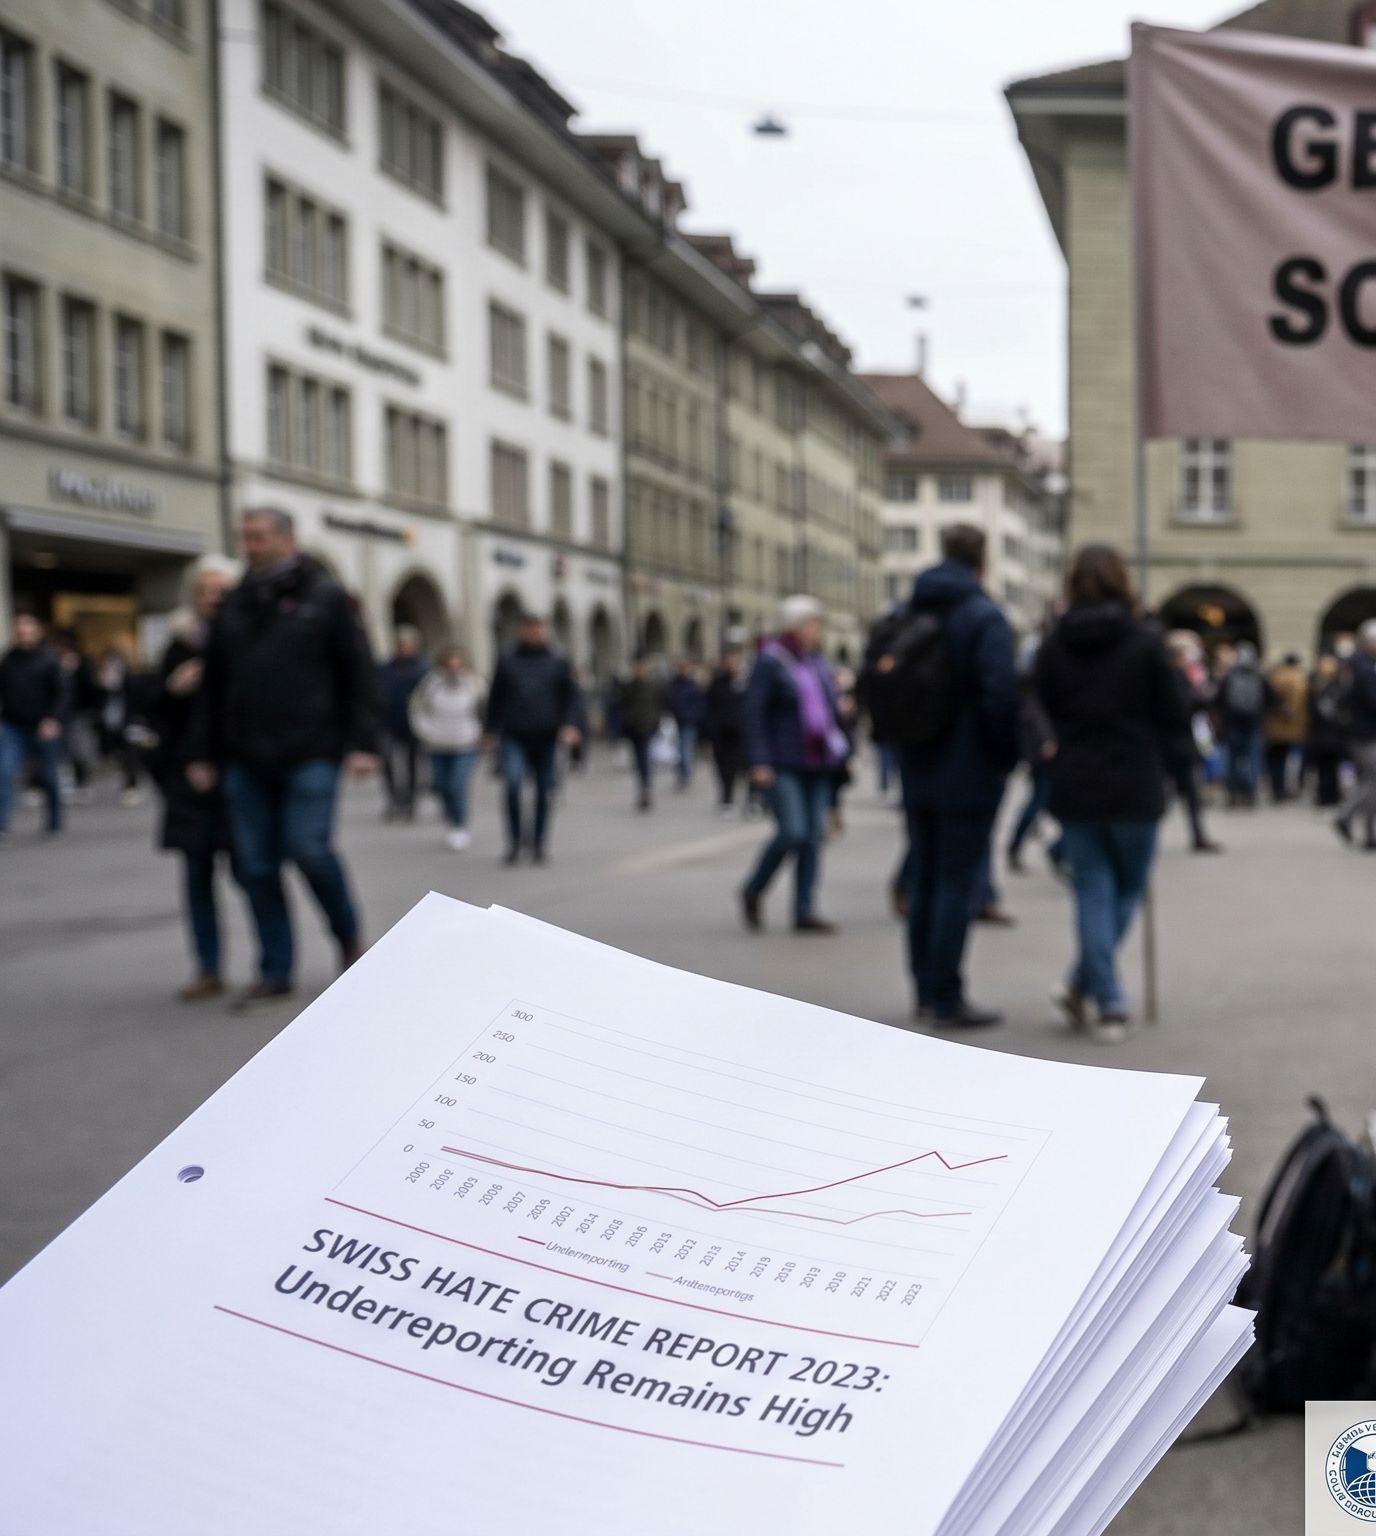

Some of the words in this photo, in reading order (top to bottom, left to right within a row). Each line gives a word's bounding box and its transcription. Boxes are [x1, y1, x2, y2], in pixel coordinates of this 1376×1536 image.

[510, 1009, 534, 1022] 300
[472, 1050, 497, 1064] 200
[453, 1072, 478, 1086] 150
[433, 1094, 458, 1107] 100
[416, 1118, 436, 1130] 50
[402, 1143, 415, 1153] 0
[404, 1161, 431, 1184] 2000
[502, 1191, 527, 1214] 2007
[875, 1279, 898, 1302] 2022
[900, 1283, 923, 1307] 2023
[302, 1229, 420, 1282] SWISS
[420, 1266, 521, 1314] HATE
[524, 1298, 641, 1347] CRIME
[642, 1327, 788, 1376] REPORT
[789, 1357, 890, 1392] 2023:
[274, 1264, 577, 1386] Underreporting
[582, 1359, 751, 1416] Remains
[759, 1395, 853, 1437] High
